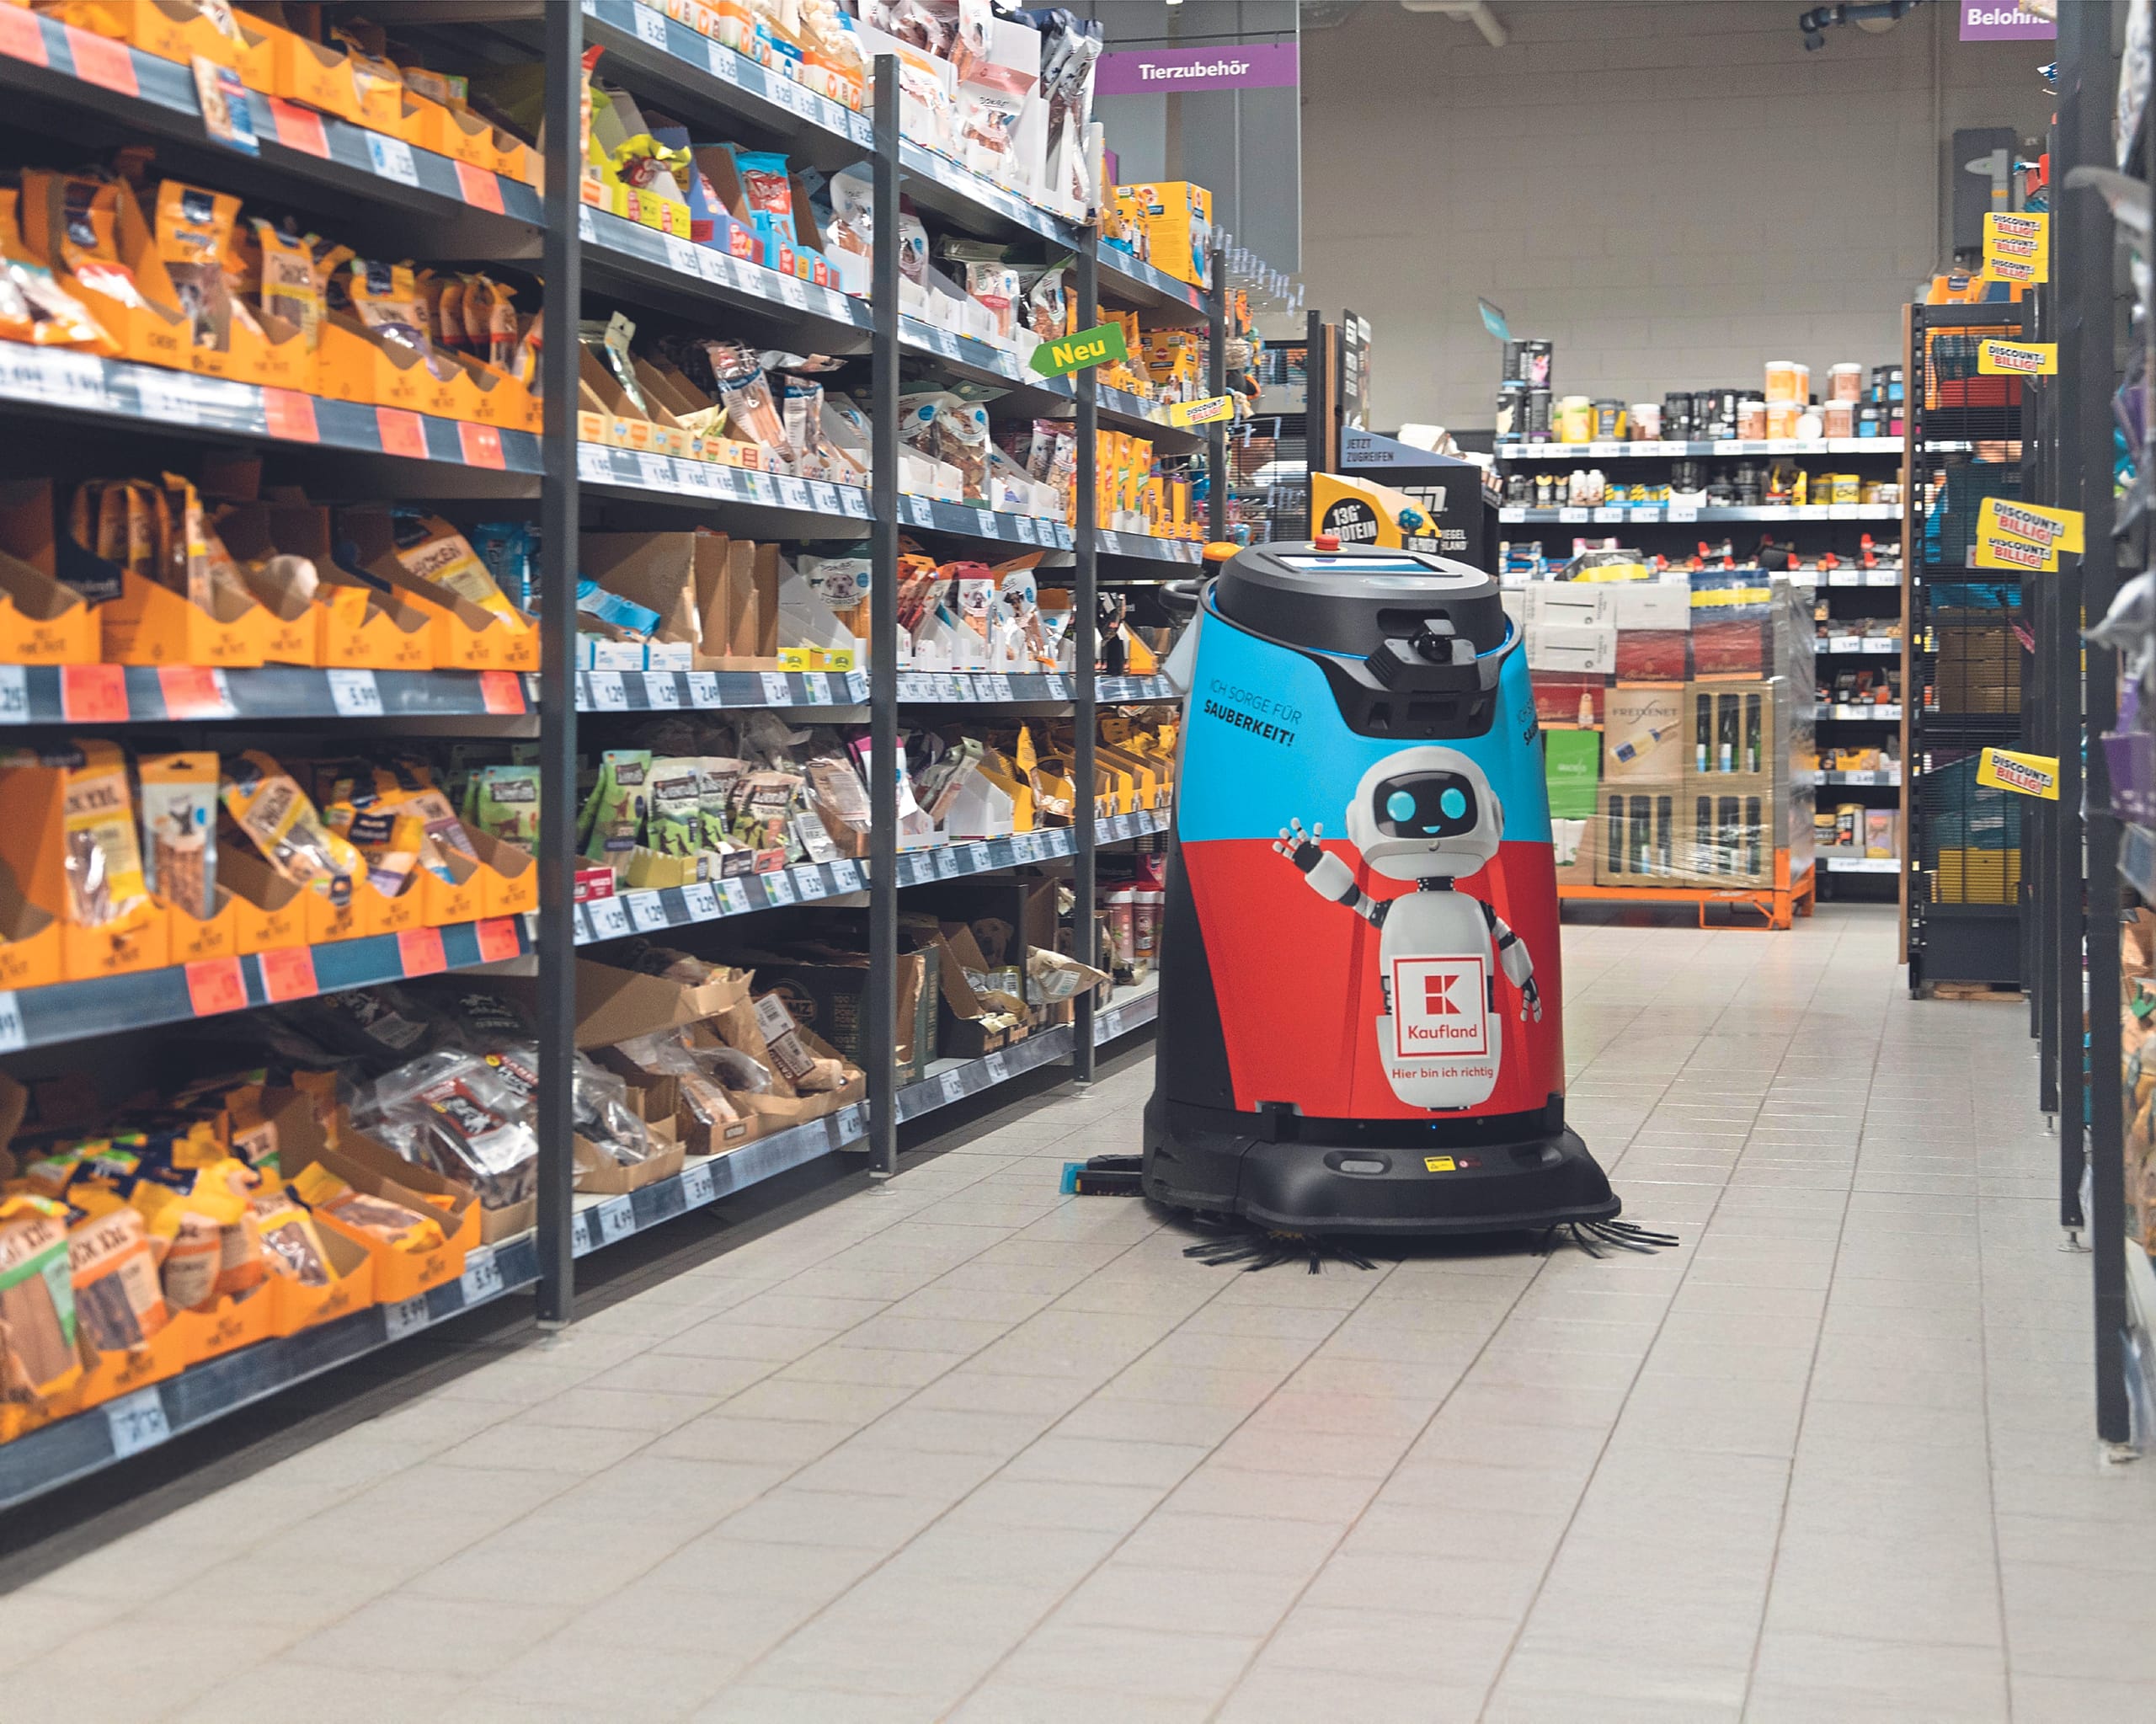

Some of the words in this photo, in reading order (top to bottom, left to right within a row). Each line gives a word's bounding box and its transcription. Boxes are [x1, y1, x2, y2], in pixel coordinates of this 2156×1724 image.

[1139, 61, 1250, 80] Tierzubehör
[1996, 222, 2034, 237] BILLIG!
[1996, 241, 2032, 256] BILLIG!
[1994, 266, 2029, 280] BILLIG!
[1052, 339, 1106, 368] Neu
[1988, 345, 2046, 364] DISCOUNT-
[1994, 355, 2037, 371] BILLIG!
[1348, 439, 1372, 450] JETZT
[1347, 451, 1394, 462] ZUGREIFEN
[1993, 503, 2062, 531] DISCOUNT-
[1999, 515, 2050, 542] BILLIG!
[1993, 546, 2041, 566] BILLIG!
[1210, 678, 1228, 696] ICH
[1228, 686, 1272, 713] SORGE
[1273, 703, 1303, 724] FÜR
[1612, 707, 1678, 717] FREIXENET
[1203, 699, 1295, 747] SAUBERKEIT!
[1993, 755, 2051, 782] DISCOUNT-
[1997, 766, 2041, 791] BILLIG!
[1408, 1024, 1477, 1038] Kaufland
[1392, 1068, 1417, 1079] Hier
[1421, 1068, 1438, 1078] bin
[1442, 1067, 1458, 1078] ich
[1461, 1066, 1493, 1078] richtig
